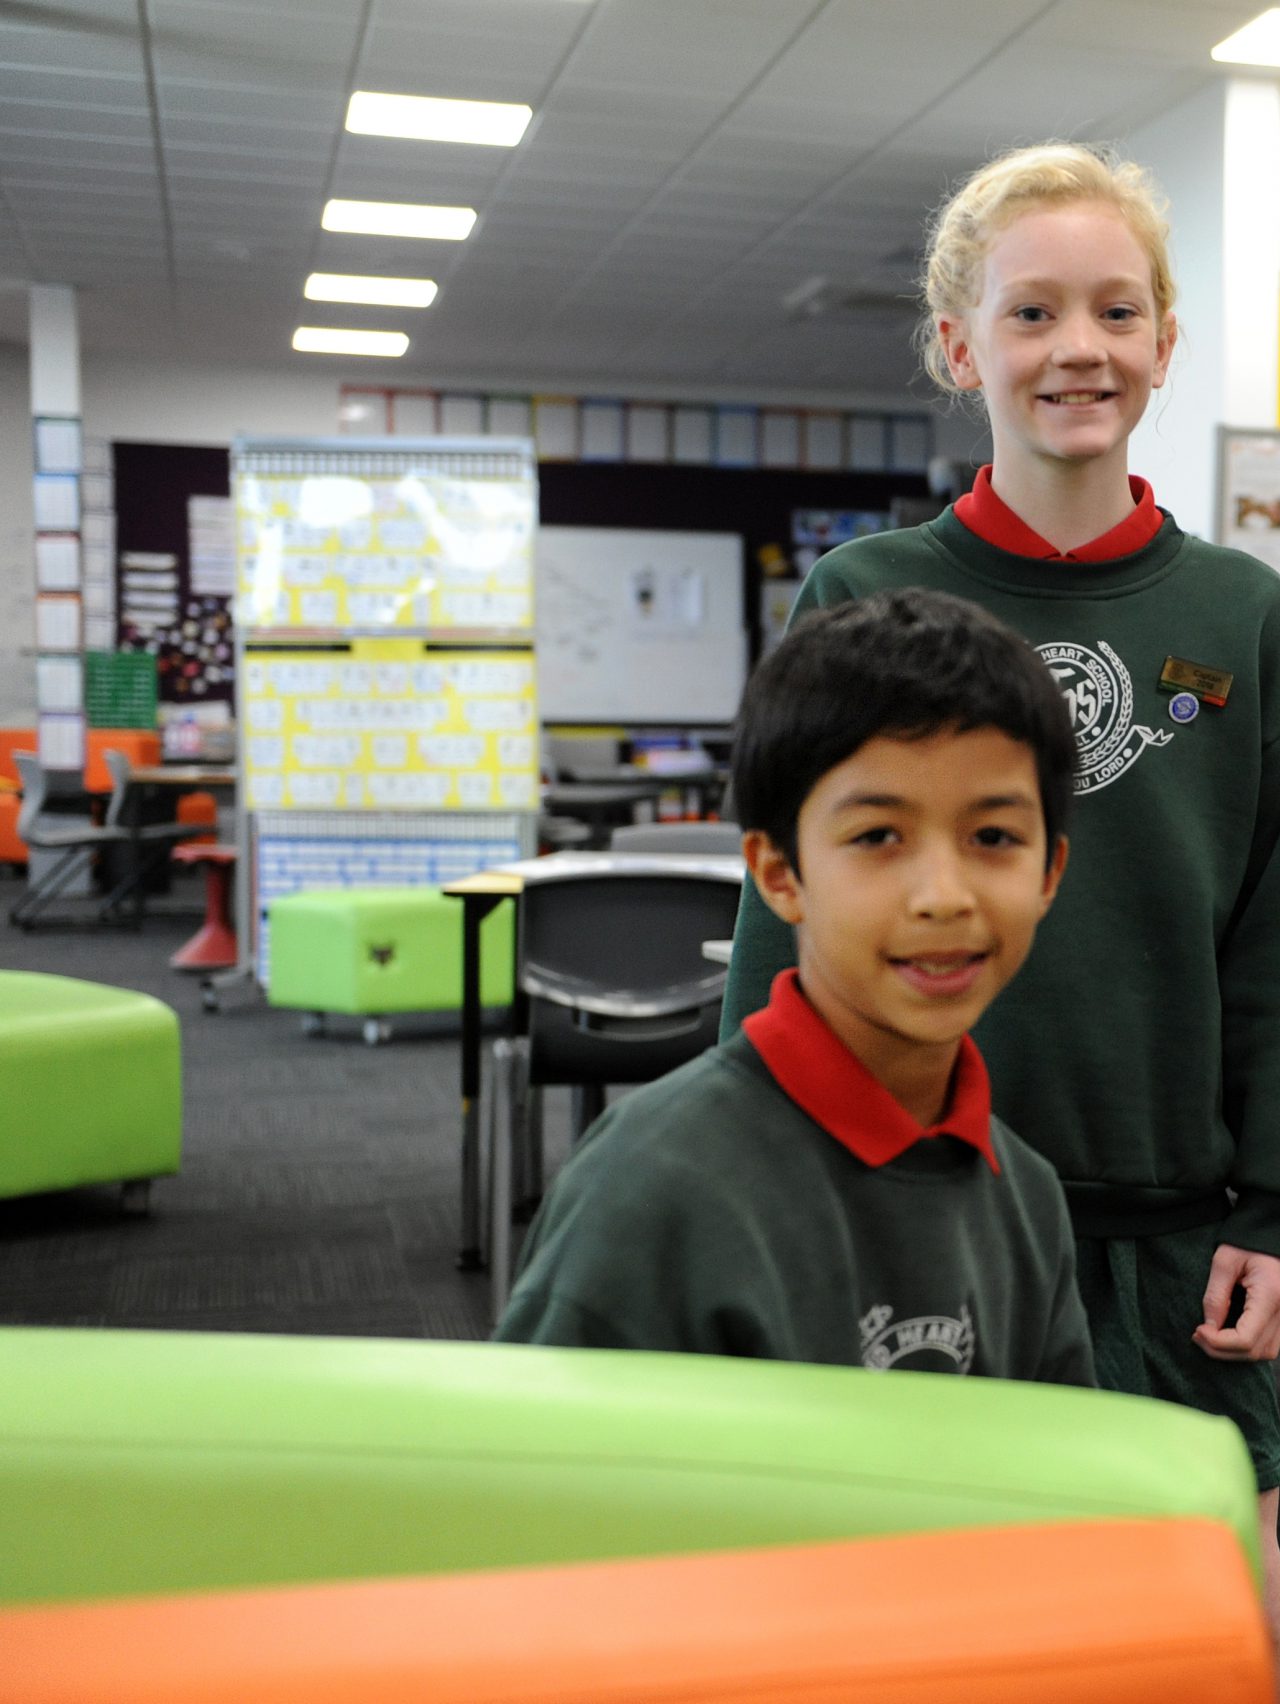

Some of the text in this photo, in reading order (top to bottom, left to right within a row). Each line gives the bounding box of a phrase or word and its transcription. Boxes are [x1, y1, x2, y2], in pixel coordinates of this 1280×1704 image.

[1040, 647, 1113, 706] HEART SCHOOL
[1094, 756, 1125, 783] LORD
